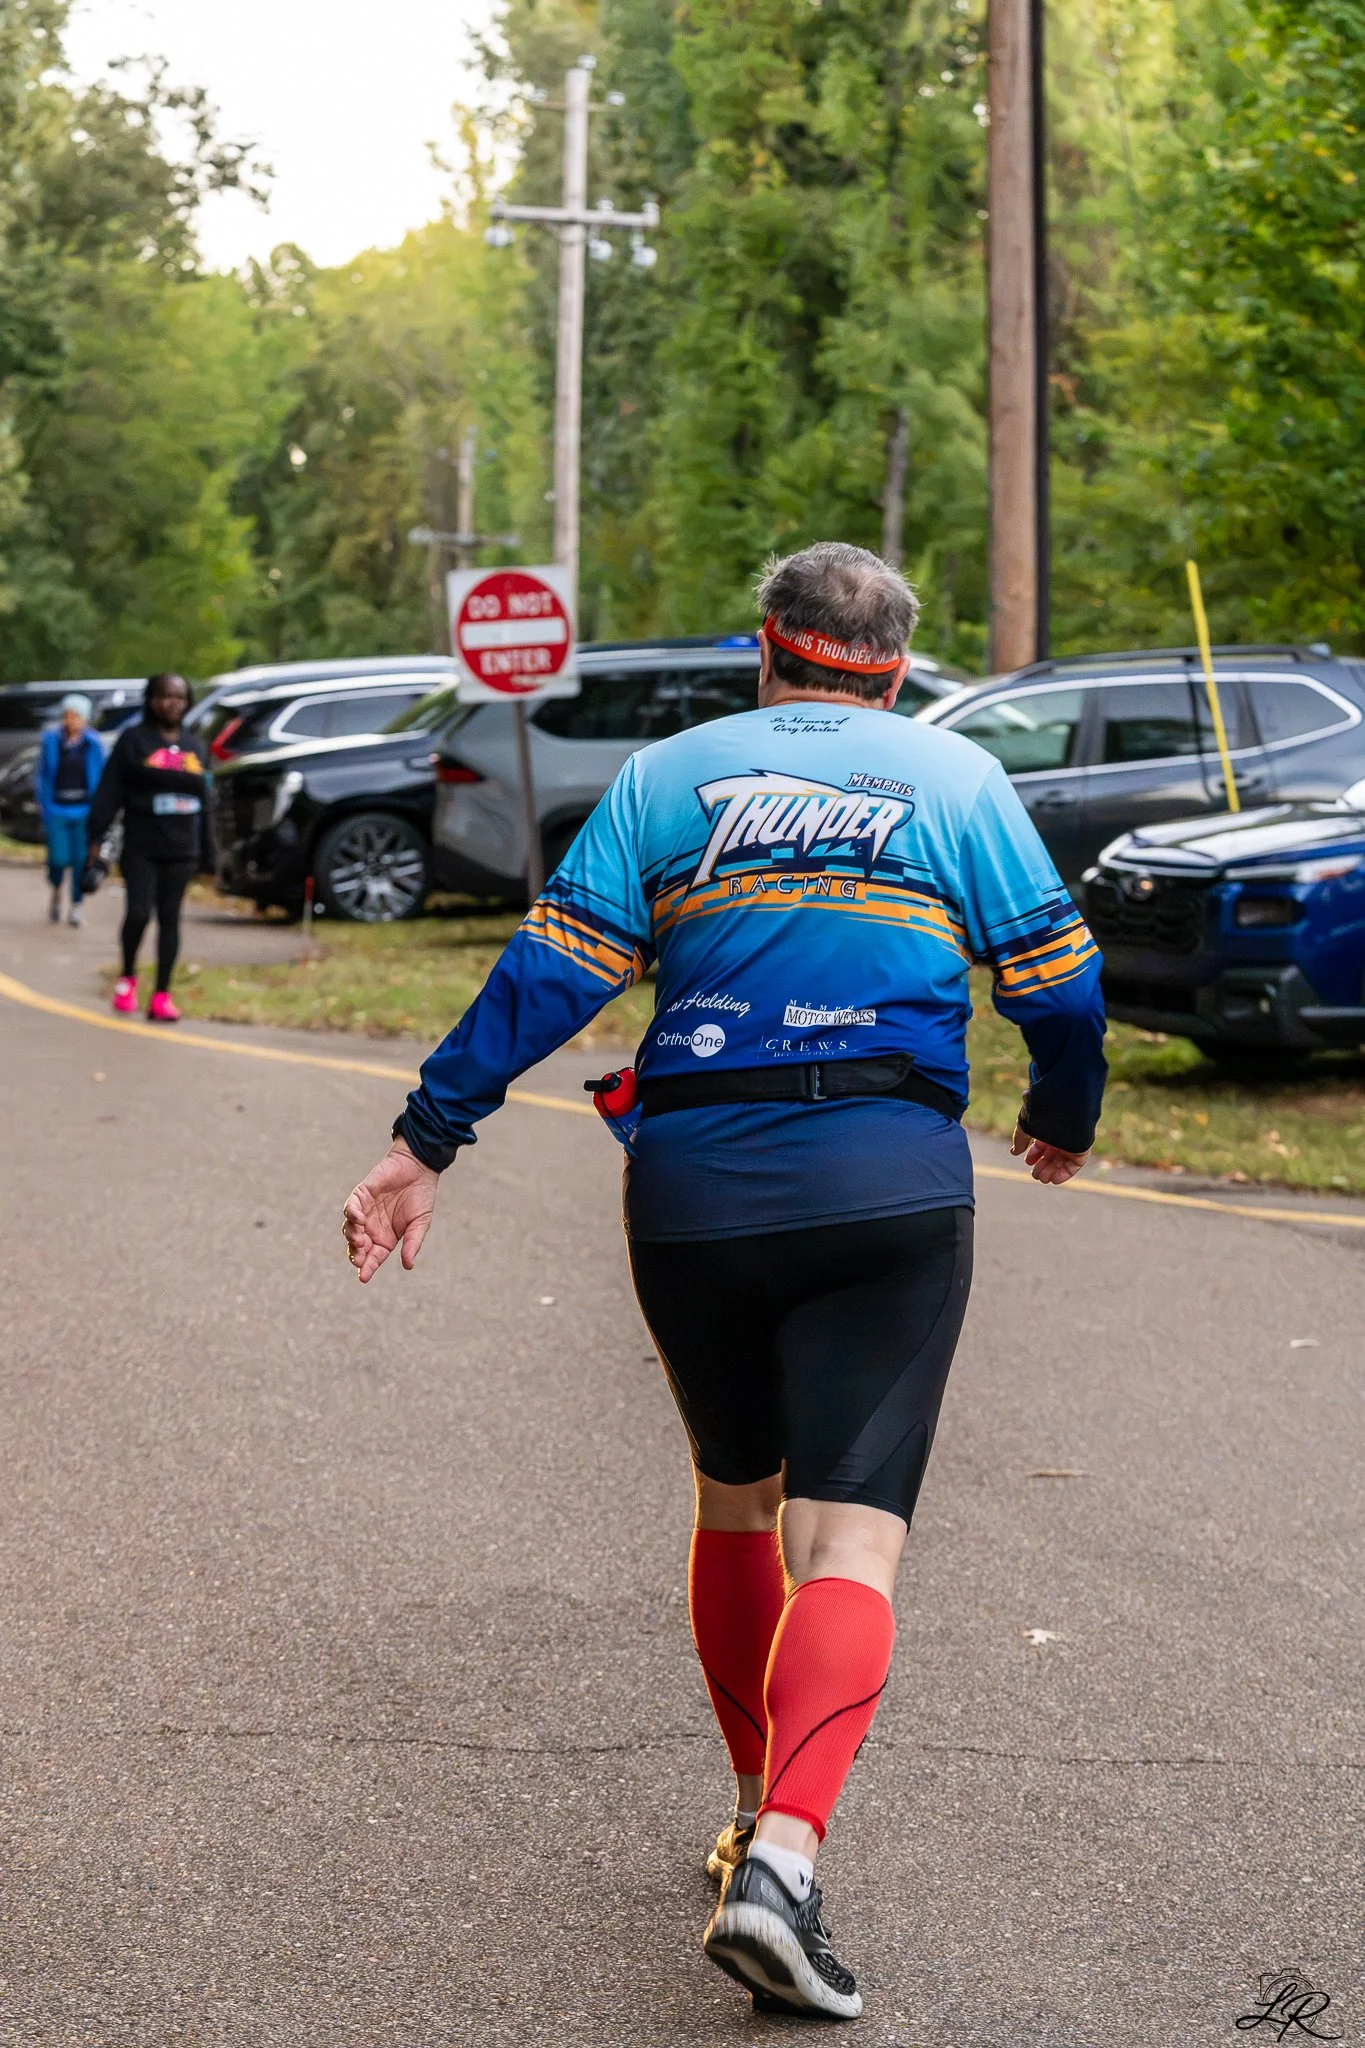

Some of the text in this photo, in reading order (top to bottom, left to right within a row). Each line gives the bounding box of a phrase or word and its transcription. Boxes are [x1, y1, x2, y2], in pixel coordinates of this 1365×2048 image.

[467, 591, 552, 620] DO NOT
[480, 648, 552, 675] ENTER
[788, 717, 831, 725] Memory
[834, 717, 850, 725] of
[691, 770, 911, 888] THUNDER
[728, 875, 857, 899] RACING
[833, 1010, 874, 1024] WERKS
[657, 1032, 724, 1048] OrthoOne
[765, 1039, 847, 1052] CREWS
